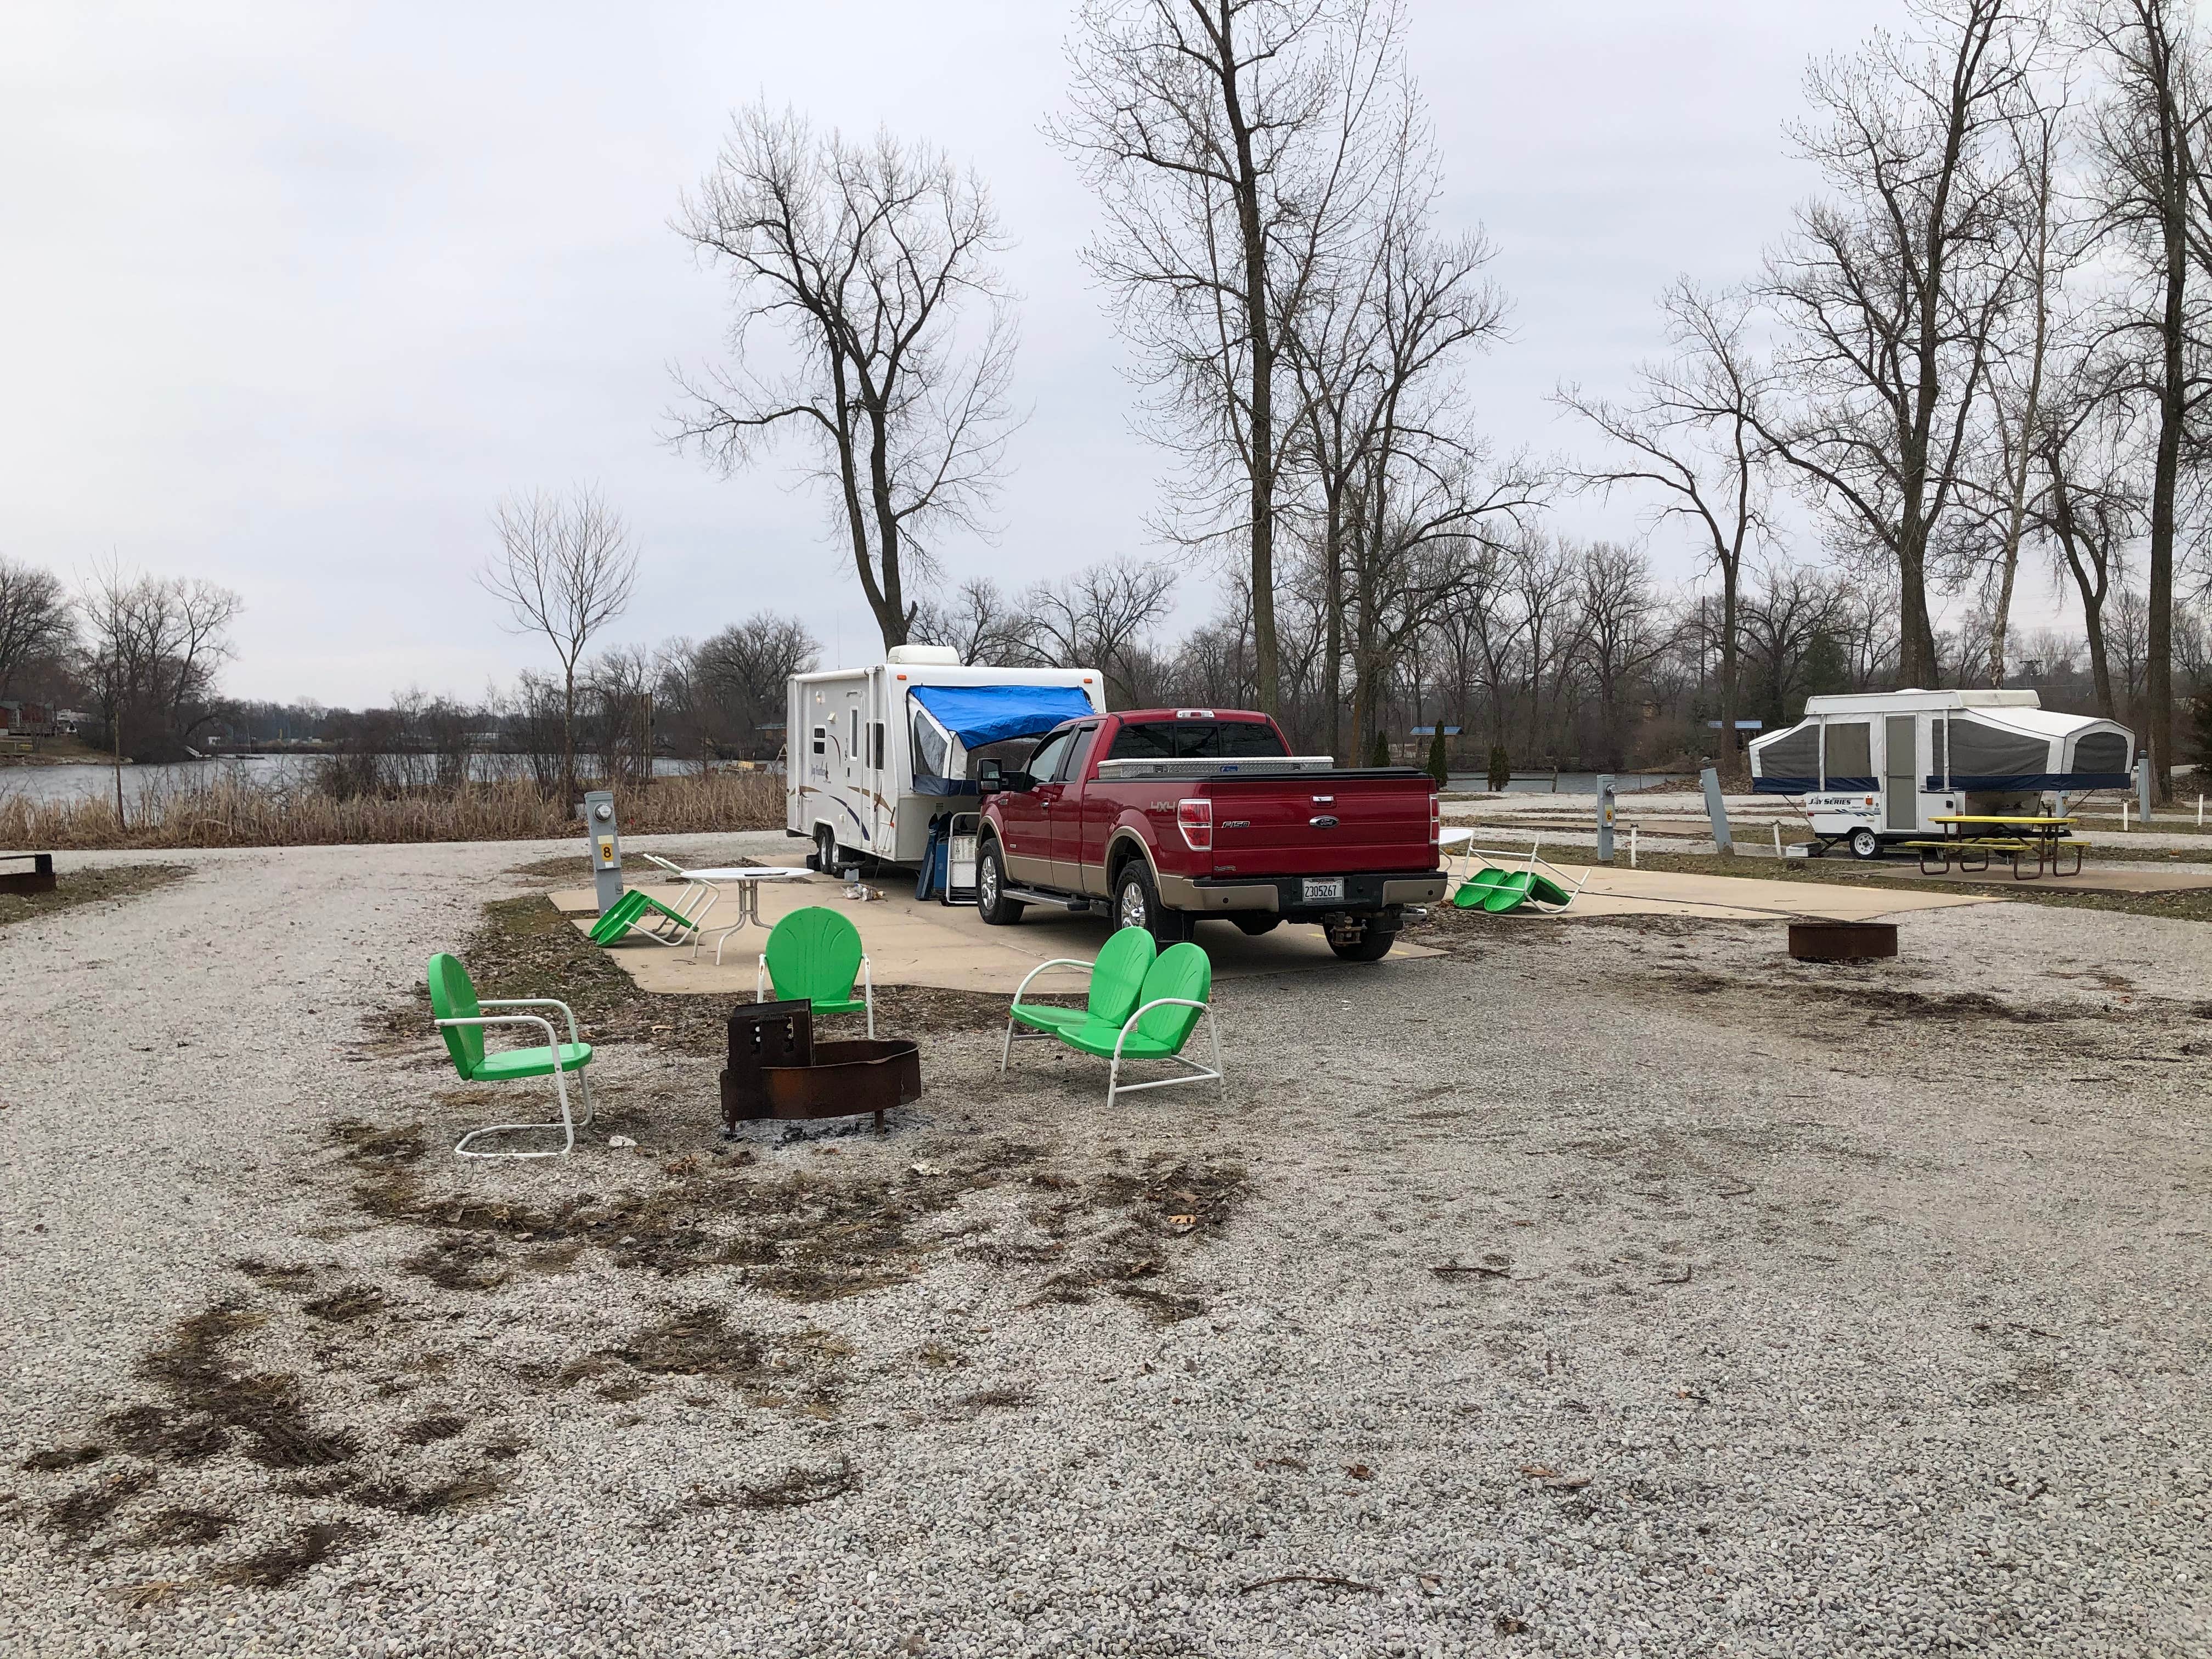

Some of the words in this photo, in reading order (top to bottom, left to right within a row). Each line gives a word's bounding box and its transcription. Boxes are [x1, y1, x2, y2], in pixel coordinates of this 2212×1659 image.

[1607, 812, 1612, 820] 6
[603, 847, 611, 858] 8
[1305, 885, 1337, 898] 2305267
